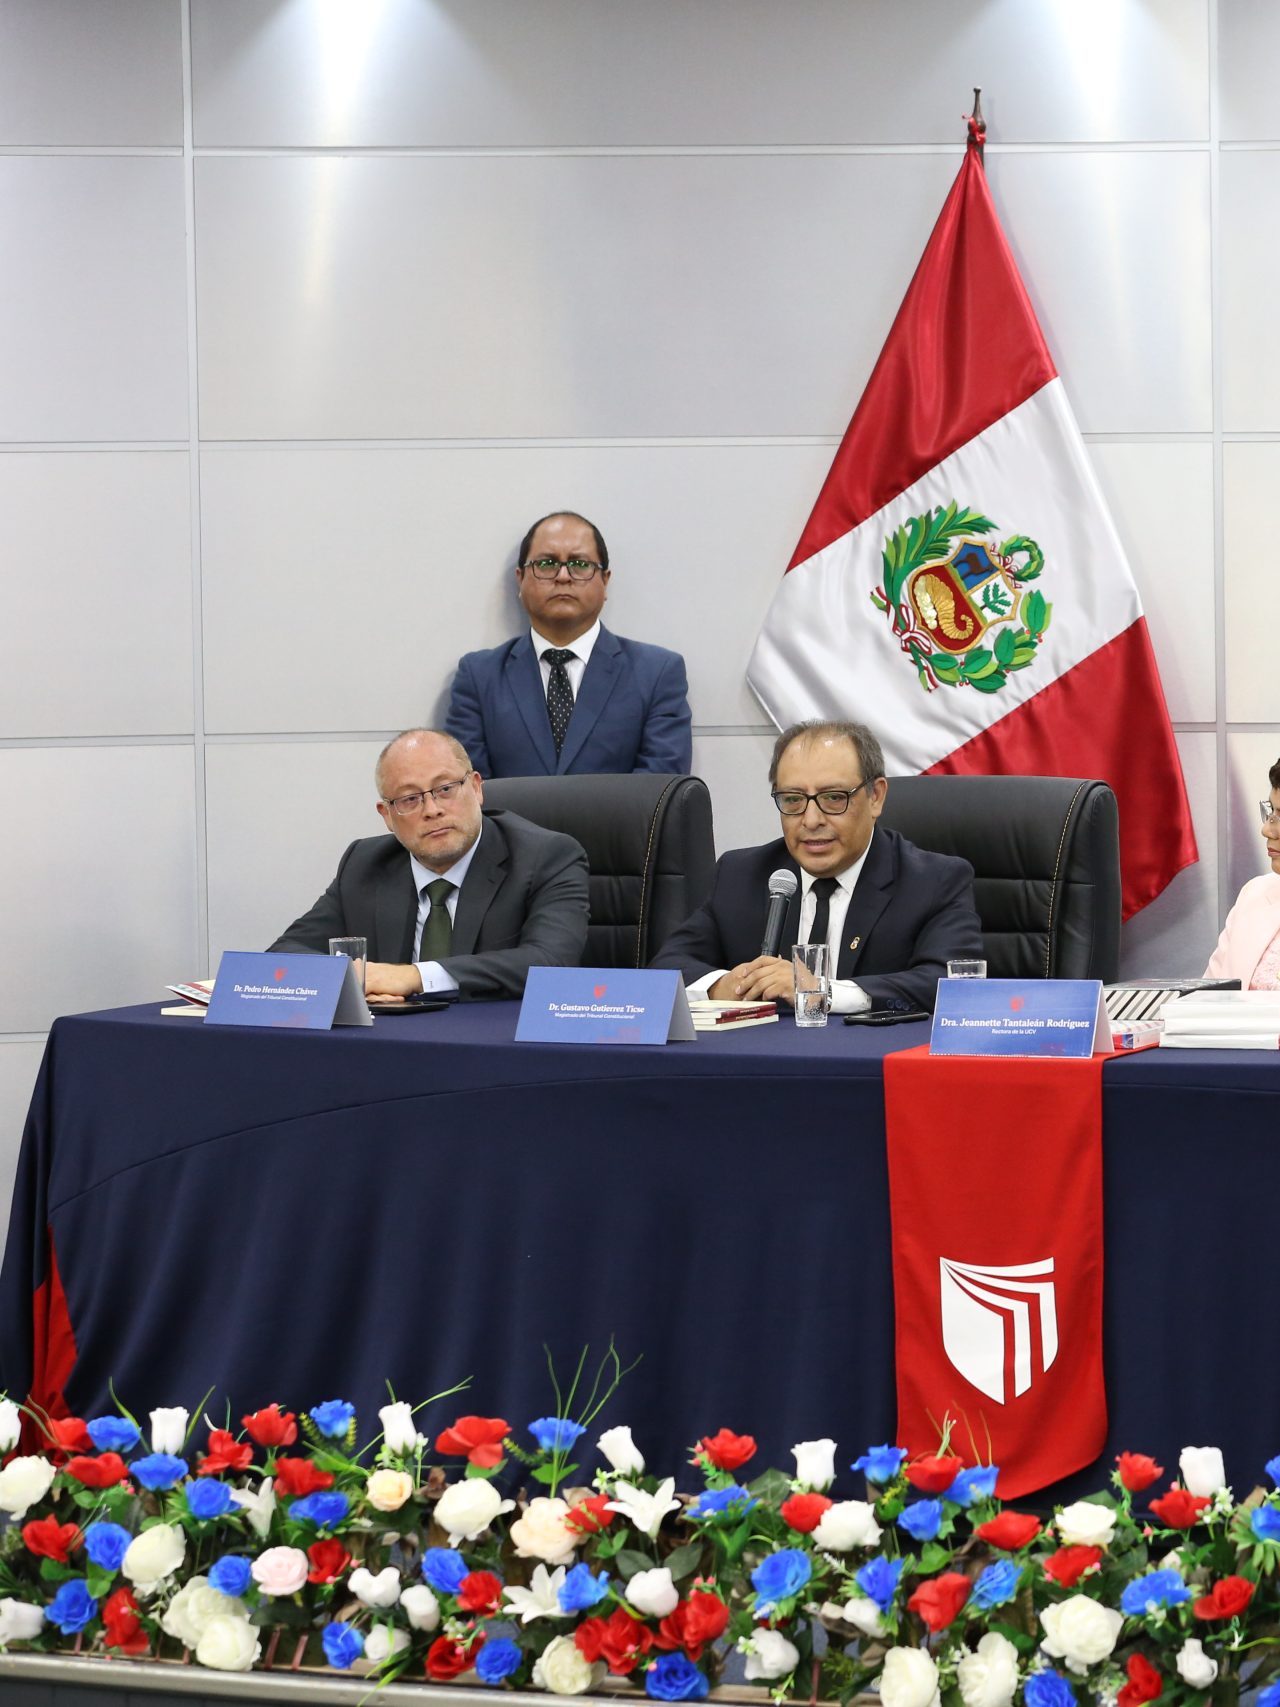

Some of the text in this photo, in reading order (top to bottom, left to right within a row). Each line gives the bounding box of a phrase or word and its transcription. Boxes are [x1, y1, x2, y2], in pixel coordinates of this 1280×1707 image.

[233, 984, 318, 996] Dr. Pedro Hernández Chávez
[548, 1003, 645, 1014] Dr. Gustavo Gutierrez Ticse
[940, 1018, 1090, 1030] Dra. Jeannette Tantaleán Rodríguez
